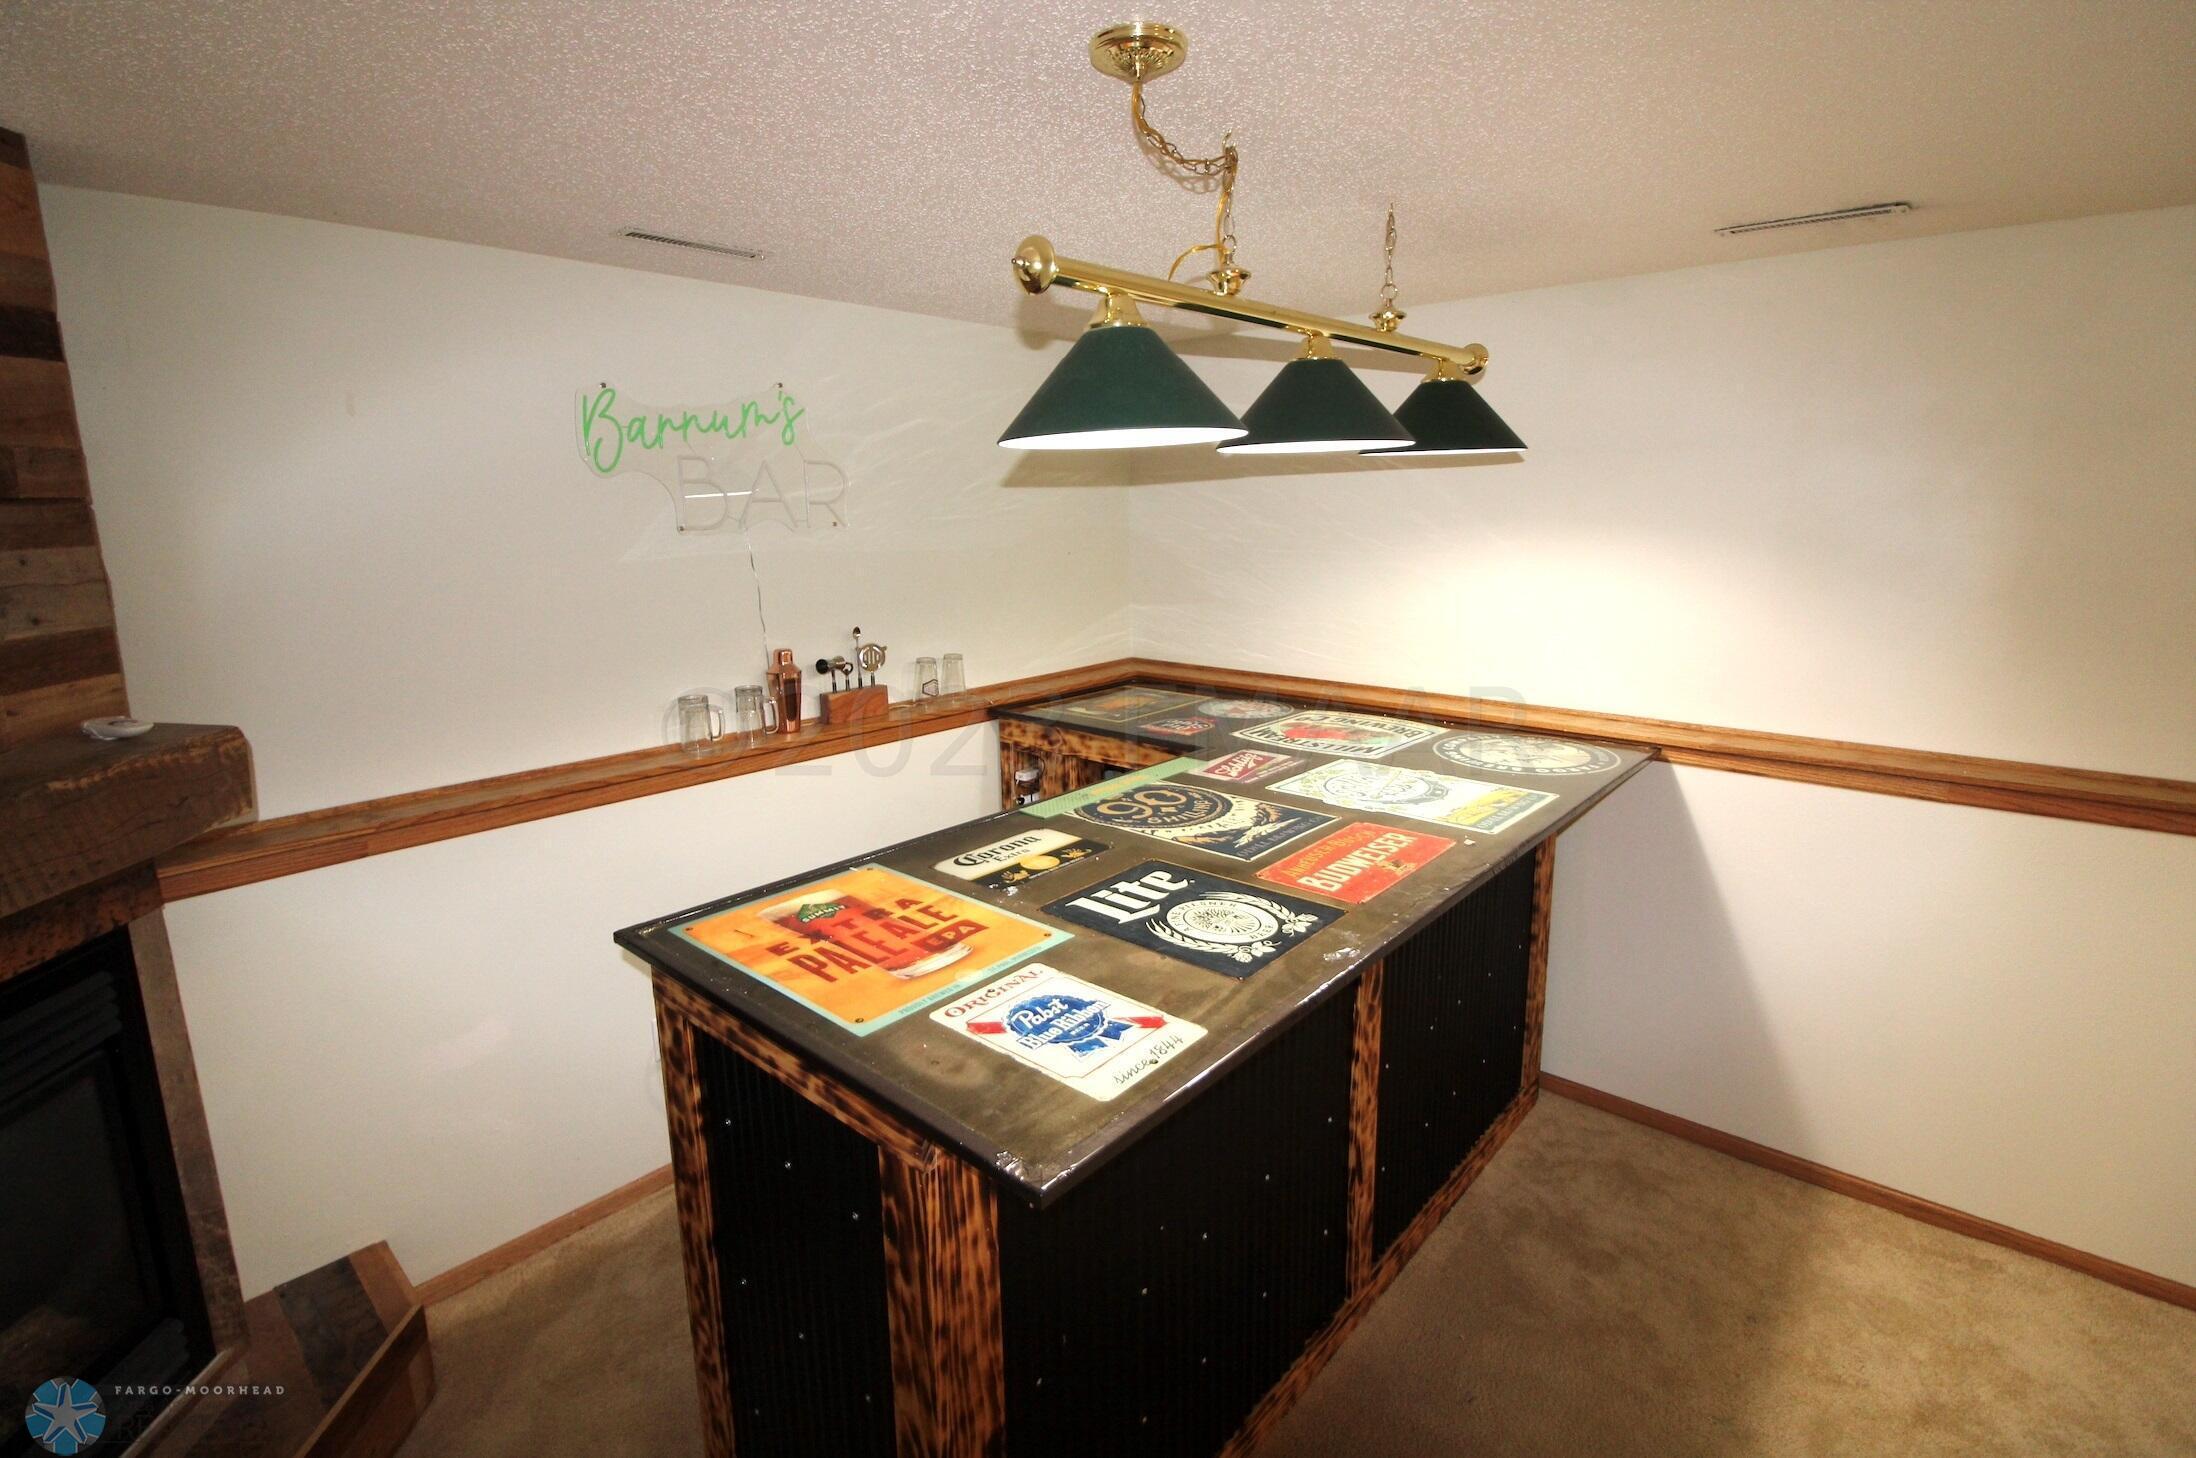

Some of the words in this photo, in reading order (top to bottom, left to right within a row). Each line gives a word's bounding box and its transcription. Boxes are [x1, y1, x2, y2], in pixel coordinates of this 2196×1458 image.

[583, 388, 805, 473] Barnum's
[677, 455, 848, 530] BAR
[1250, 729, 1382, 754] MILLSTREAM
[1329, 716, 1422, 739] BREWING
[1214, 752, 1264, 778] Schlitz
[1096, 789, 1189, 820] 90
[1147, 798, 1213, 825] SHILLING
[953, 835, 1042, 867] Corona
[993, 849, 1032, 863] Extra
[1297, 832, 1419, 892] BUDWEISER
[1065, 870, 1189, 924] Lite
[766, 898, 925, 956] EXTRA
[801, 904, 846, 923] SUMMIT
[787, 929, 910, 983] PALE
[879, 904, 958, 939] ALE
[925, 923, 978, 948] EPA
[944, 970, 1042, 1018] ORIGINAL
[1011, 998, 1069, 1030] Pabst
[1019, 1026, 1063, 1050] Blue
[1051, 1001, 1109, 1031] Ribbon
[1113, 1058, 1151, 1085] since
[1150, 1034, 1184, 1059] 1844
